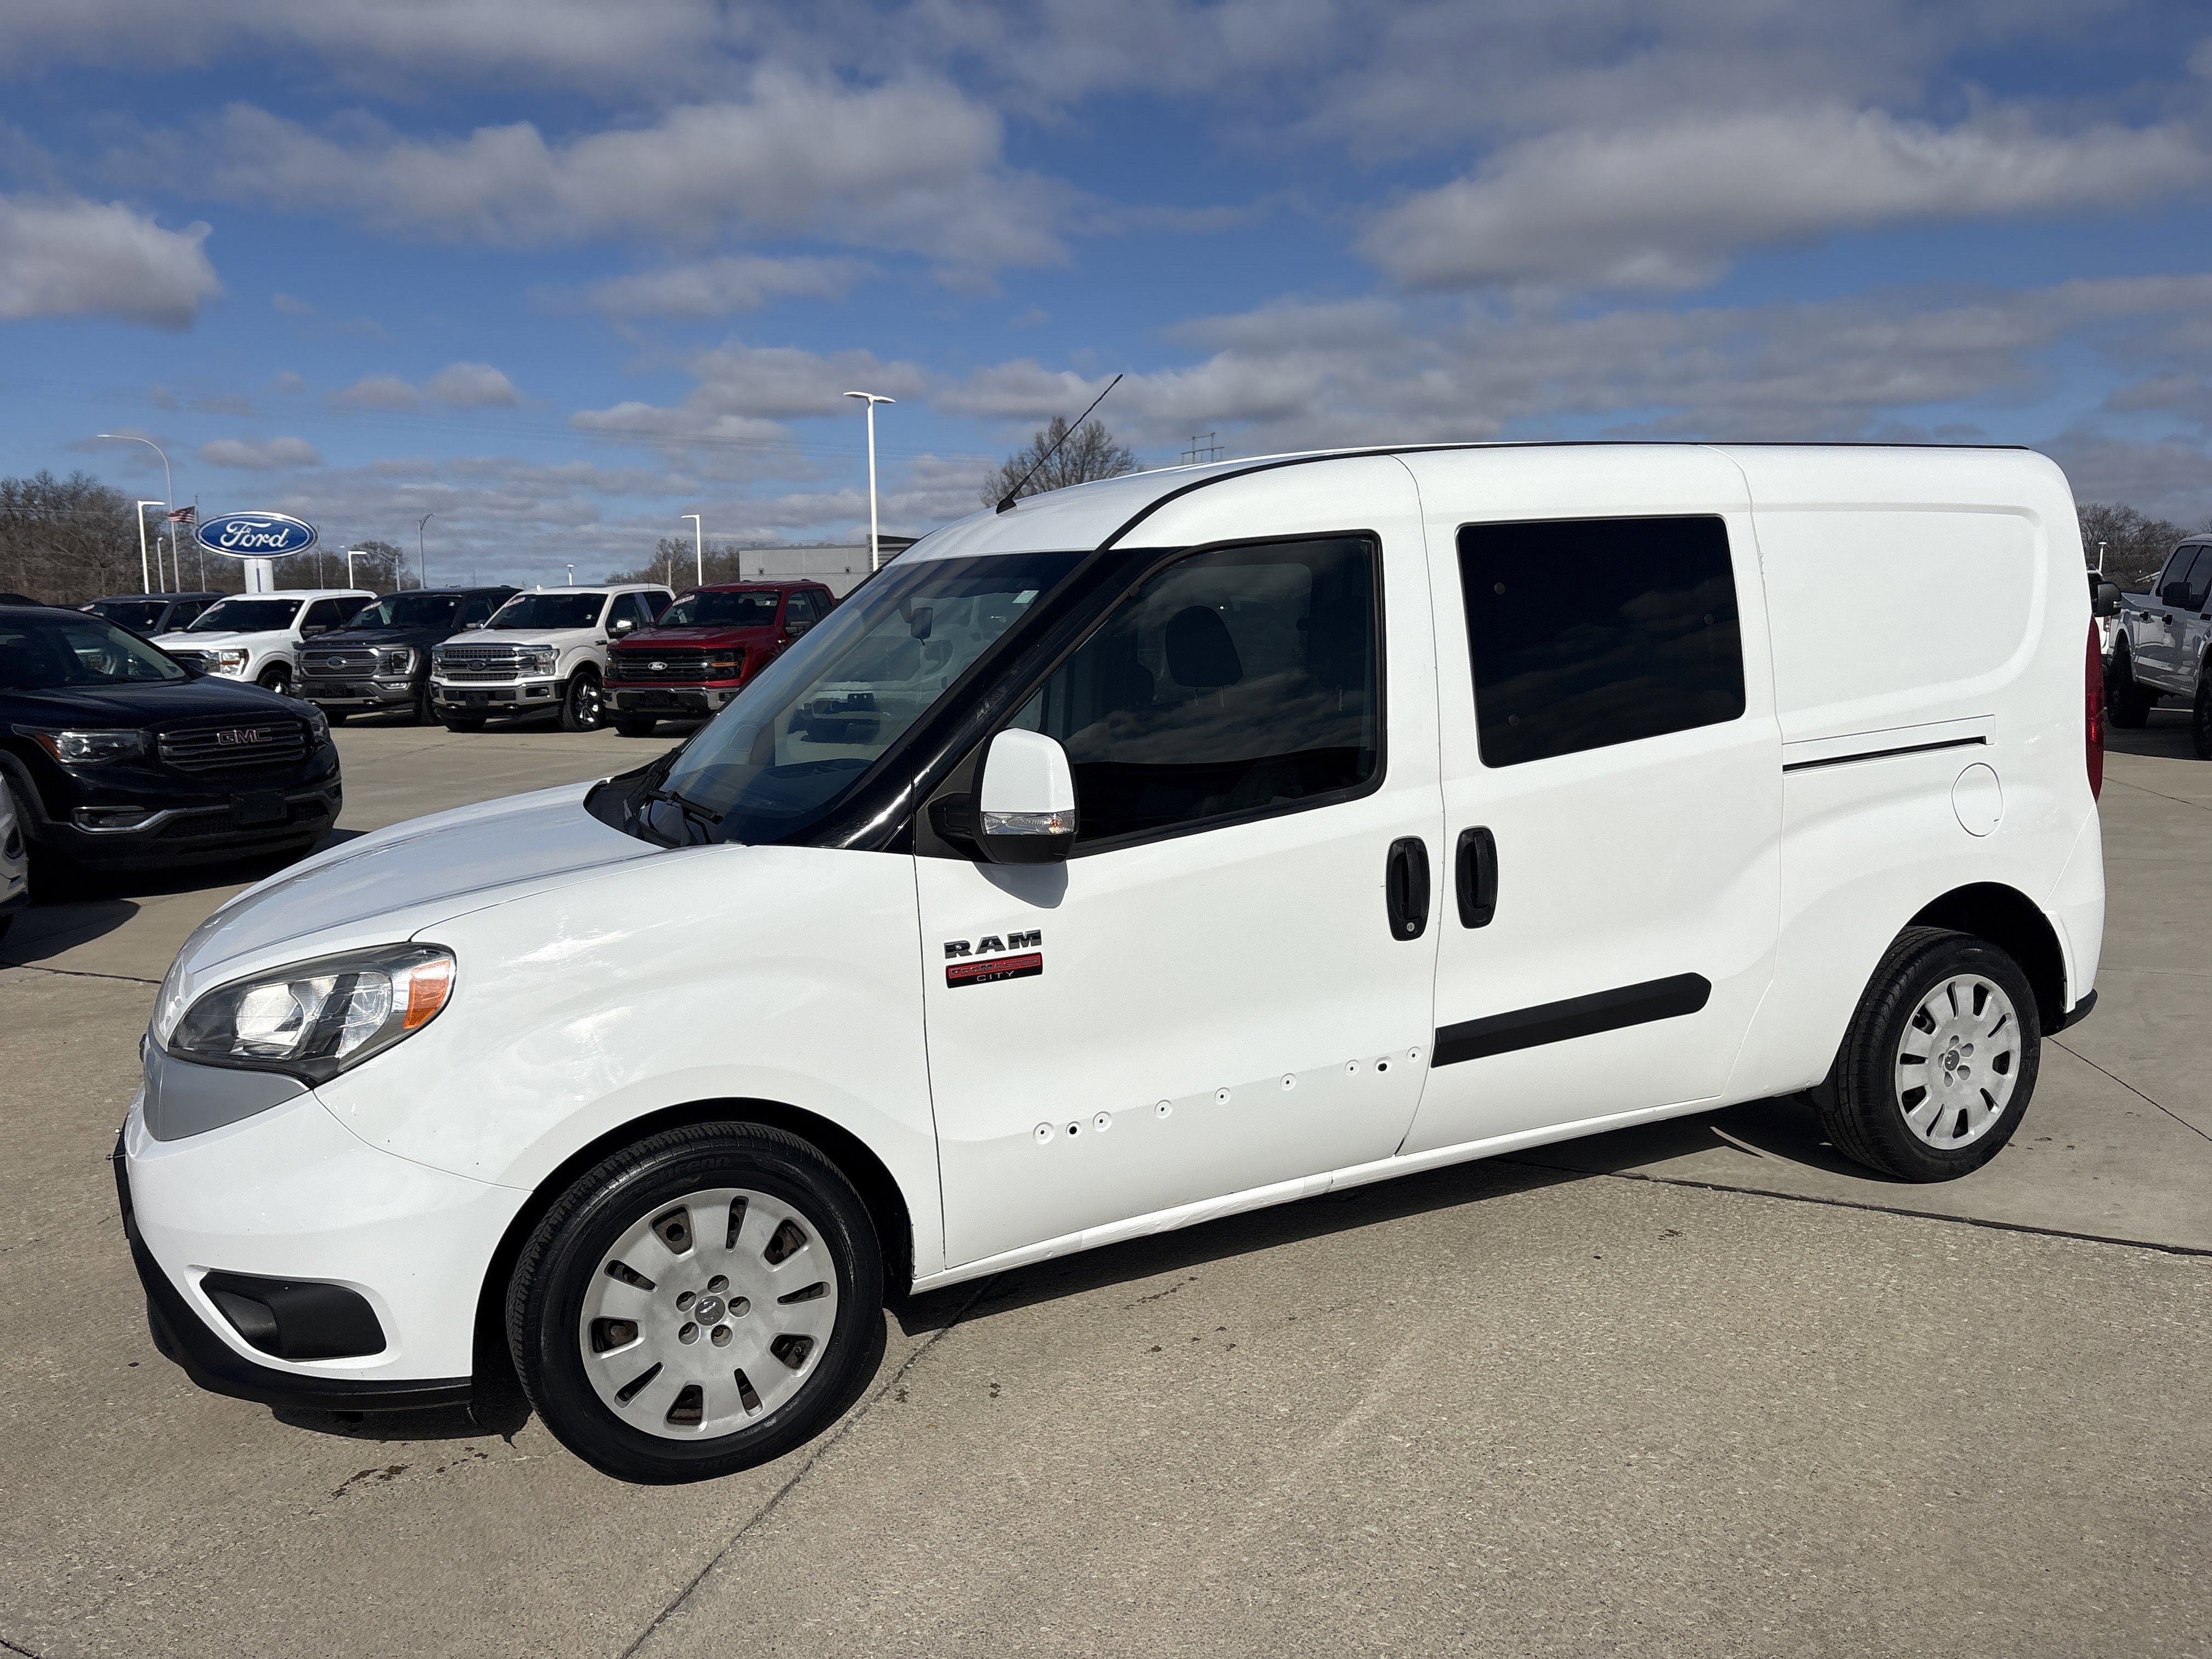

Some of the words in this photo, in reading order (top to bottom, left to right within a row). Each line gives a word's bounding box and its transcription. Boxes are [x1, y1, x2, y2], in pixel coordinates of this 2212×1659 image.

[220, 521, 290, 548] Ford
[217, 727, 272, 745] GMC
[944, 929, 1042, 959] RAM
[977, 970, 1014, 982] CITY
